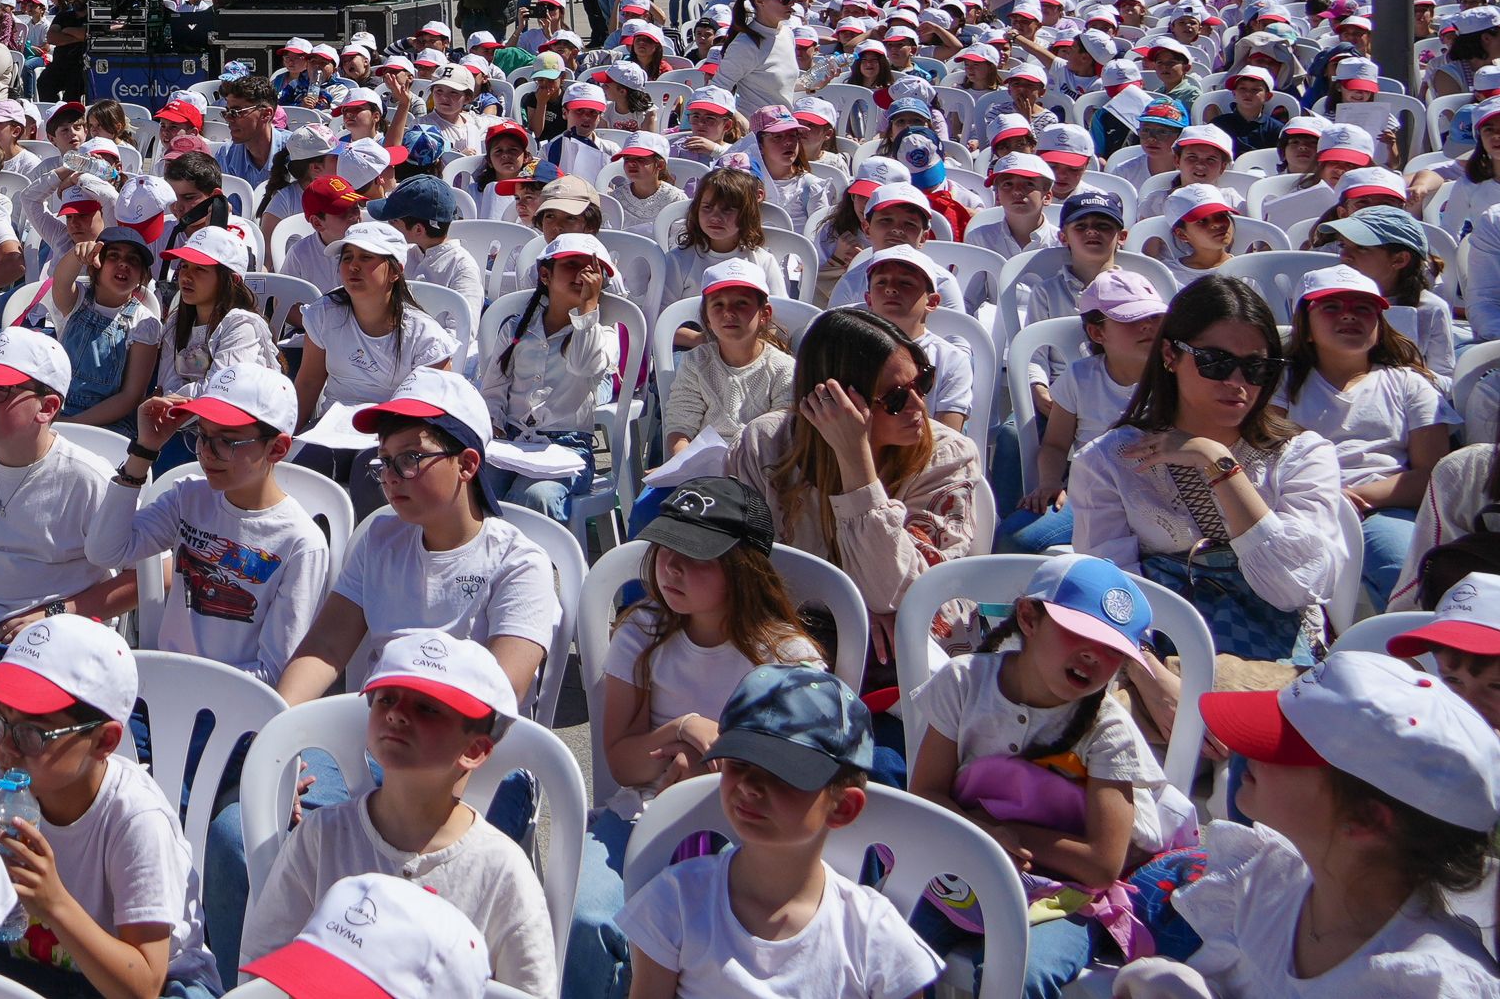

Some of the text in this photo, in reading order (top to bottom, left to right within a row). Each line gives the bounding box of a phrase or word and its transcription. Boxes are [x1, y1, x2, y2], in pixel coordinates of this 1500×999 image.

[442, 67, 454, 78] E
[210, 384, 230, 394] CAYMA
[455, 574, 487, 586] SILBON
[14, 644, 41, 660] CAYMA
[411, 658, 448, 673] CAYMA
[325, 920, 364, 947] CAYMA
